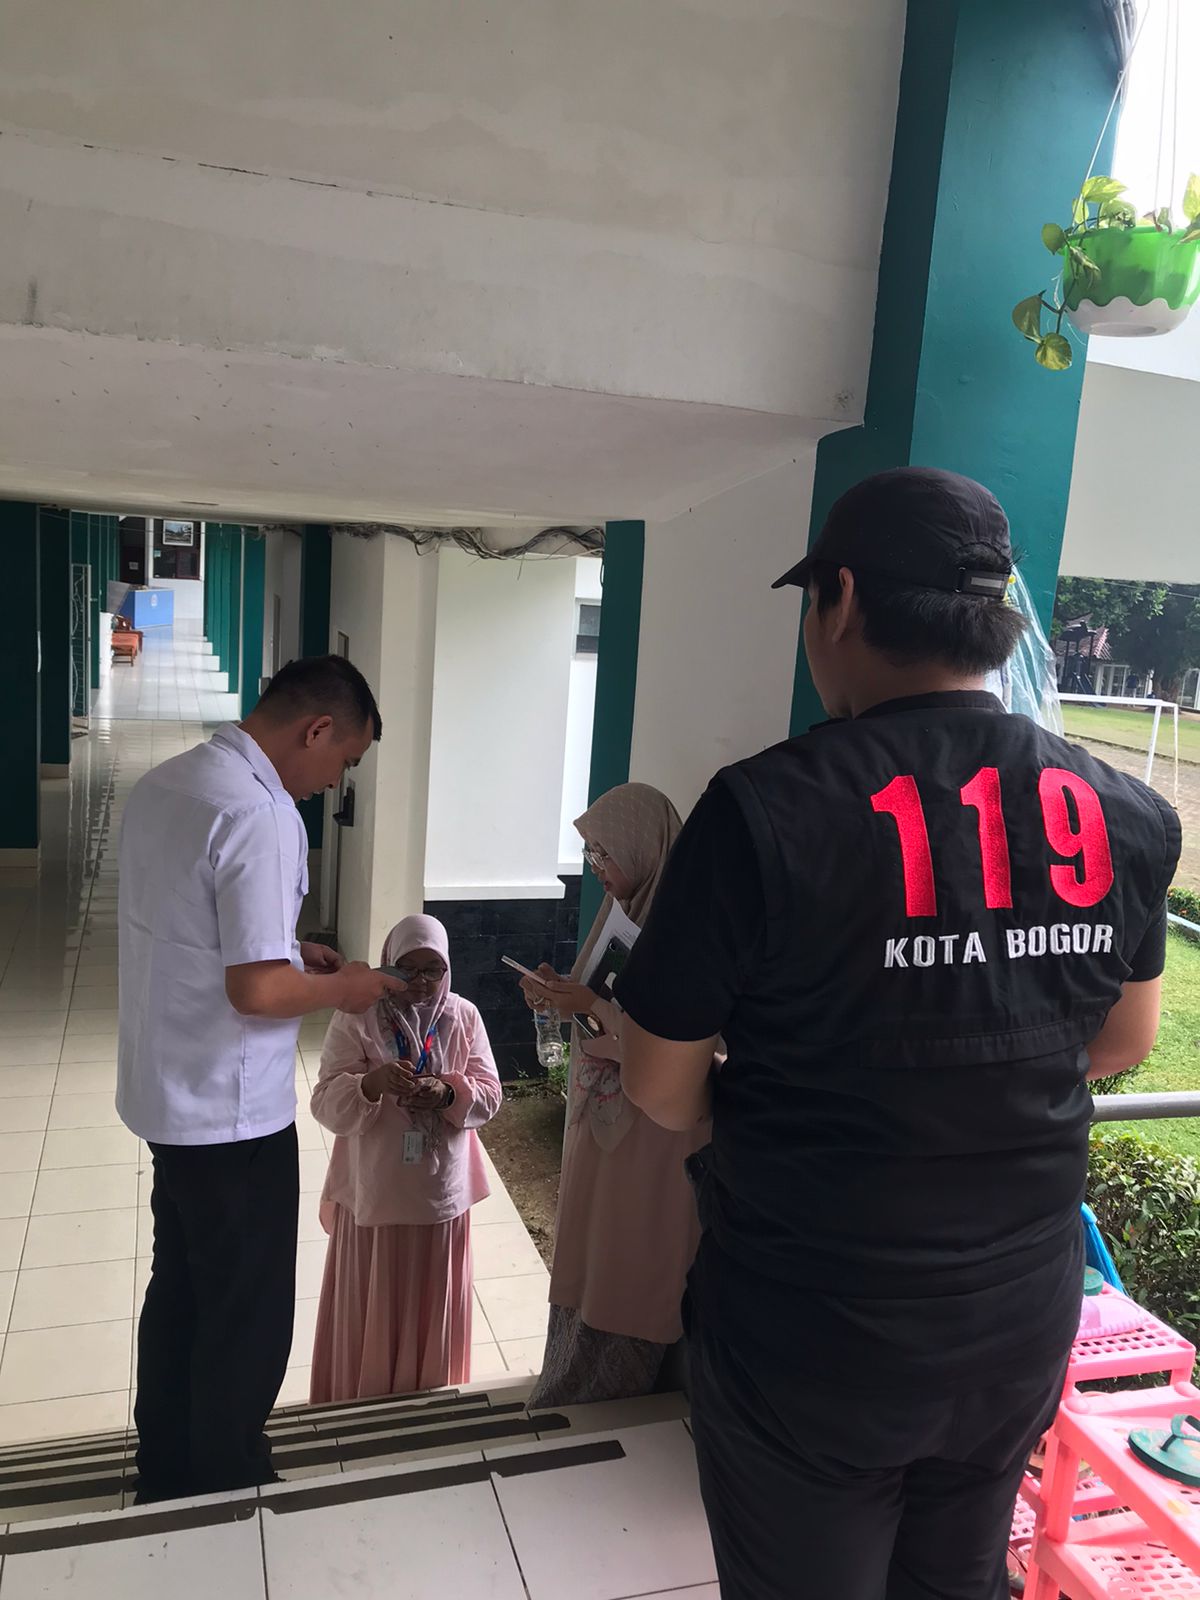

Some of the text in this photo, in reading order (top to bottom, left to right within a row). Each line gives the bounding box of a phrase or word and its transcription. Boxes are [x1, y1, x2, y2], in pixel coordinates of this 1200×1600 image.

[870, 767, 1114, 917] 119
[884, 923, 1113, 968] KOTA BOGOR
